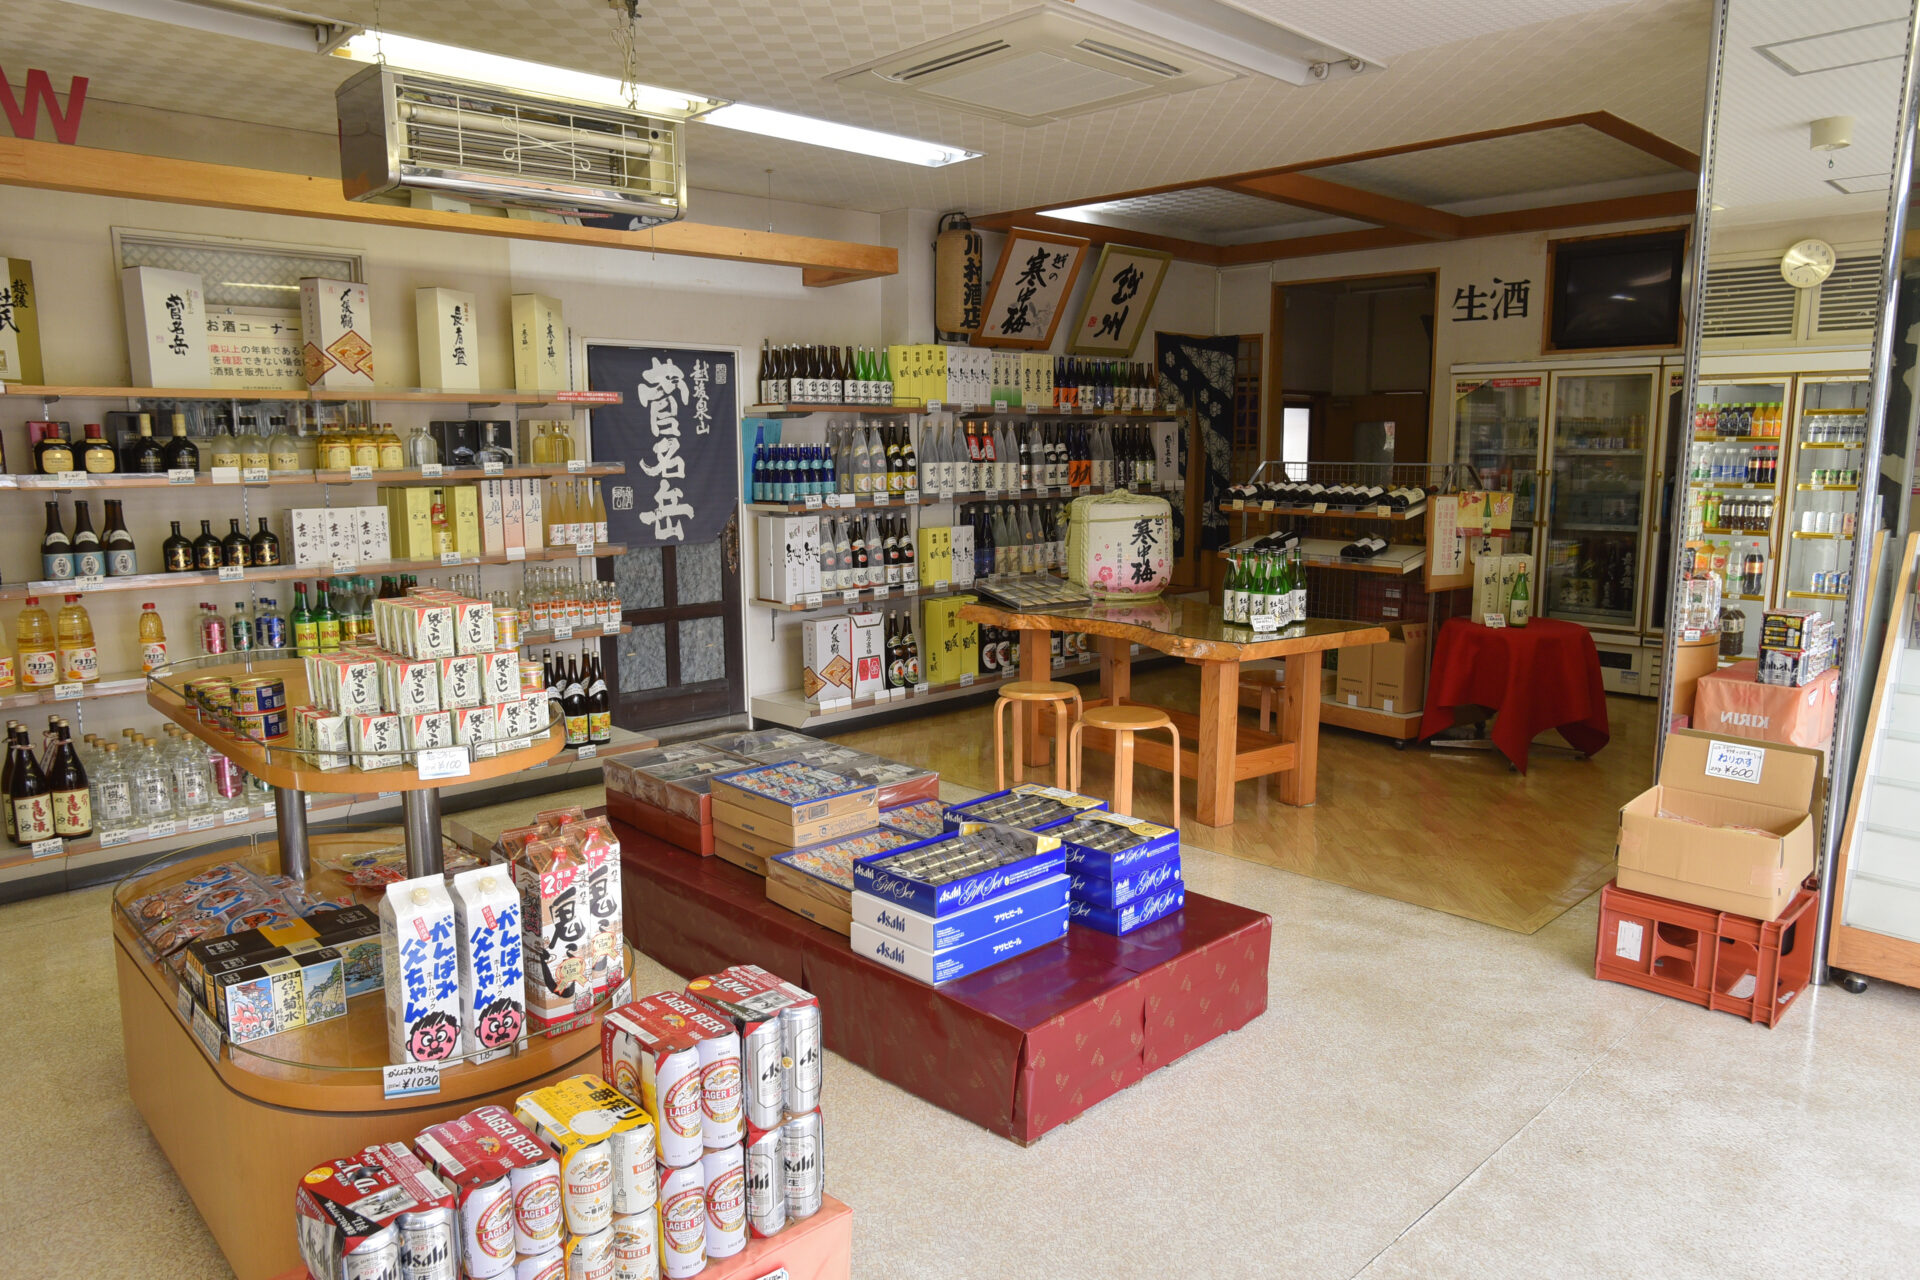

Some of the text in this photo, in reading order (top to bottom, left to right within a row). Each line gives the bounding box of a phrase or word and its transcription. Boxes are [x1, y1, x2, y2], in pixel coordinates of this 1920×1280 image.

[1002, 247, 1050, 335] 寒中梅
[1452, 277, 1531, 322] 生酒
[166, 293, 189, 356] 菅名岳
[206, 320, 299, 334] お酒コーナー
[690, 359, 712, 434] 越後泉山
[638, 357, 695, 541] 菅名岳
[1130, 514, 1158, 585] 寒中梅
[1725, 765, 1753, 779] ¥600
[943, 810, 963, 823] Asahi
[854, 863, 874, 880] Asahi
[939, 885, 962, 903] Asahi
[877, 909, 905, 933] Asahi
[994, 907, 1023, 923] アサヒビール
[496, 903, 523, 988] がんばれ
[876, 940, 905, 965] Asahi
[993, 936, 1022, 954] アサヒビール
[429, 914, 458, 1001] がんばれ
[469, 926, 496, 1010] 父ちゃん
[401, 938, 428, 1024] 父ちゃん
[283, 998, 301, 1022] 菊水
[656, 991, 693, 1016] LAGER
[689, 1012, 726, 1033] BEER
[402, 1075, 439, 1090] ¥1030
[702, 1090, 727, 1099] LAGER
[583, 1080, 643, 1120] 一番搾り
[669, 1104, 696, 1117] LAGER
[476, 1108, 544, 1160] LAGER BEER
[572, 1184, 598, 1195] KIRIN
[519, 1209, 546, 1219] LAGER
[711, 1201, 736, 1211] LAGER
[482, 1227, 508, 1241] LAGER
[664, 1220, 691, 1230] LAGER
[401, 1241, 448, 1268] Asahi
[627, 1248, 648, 1258] BEER
